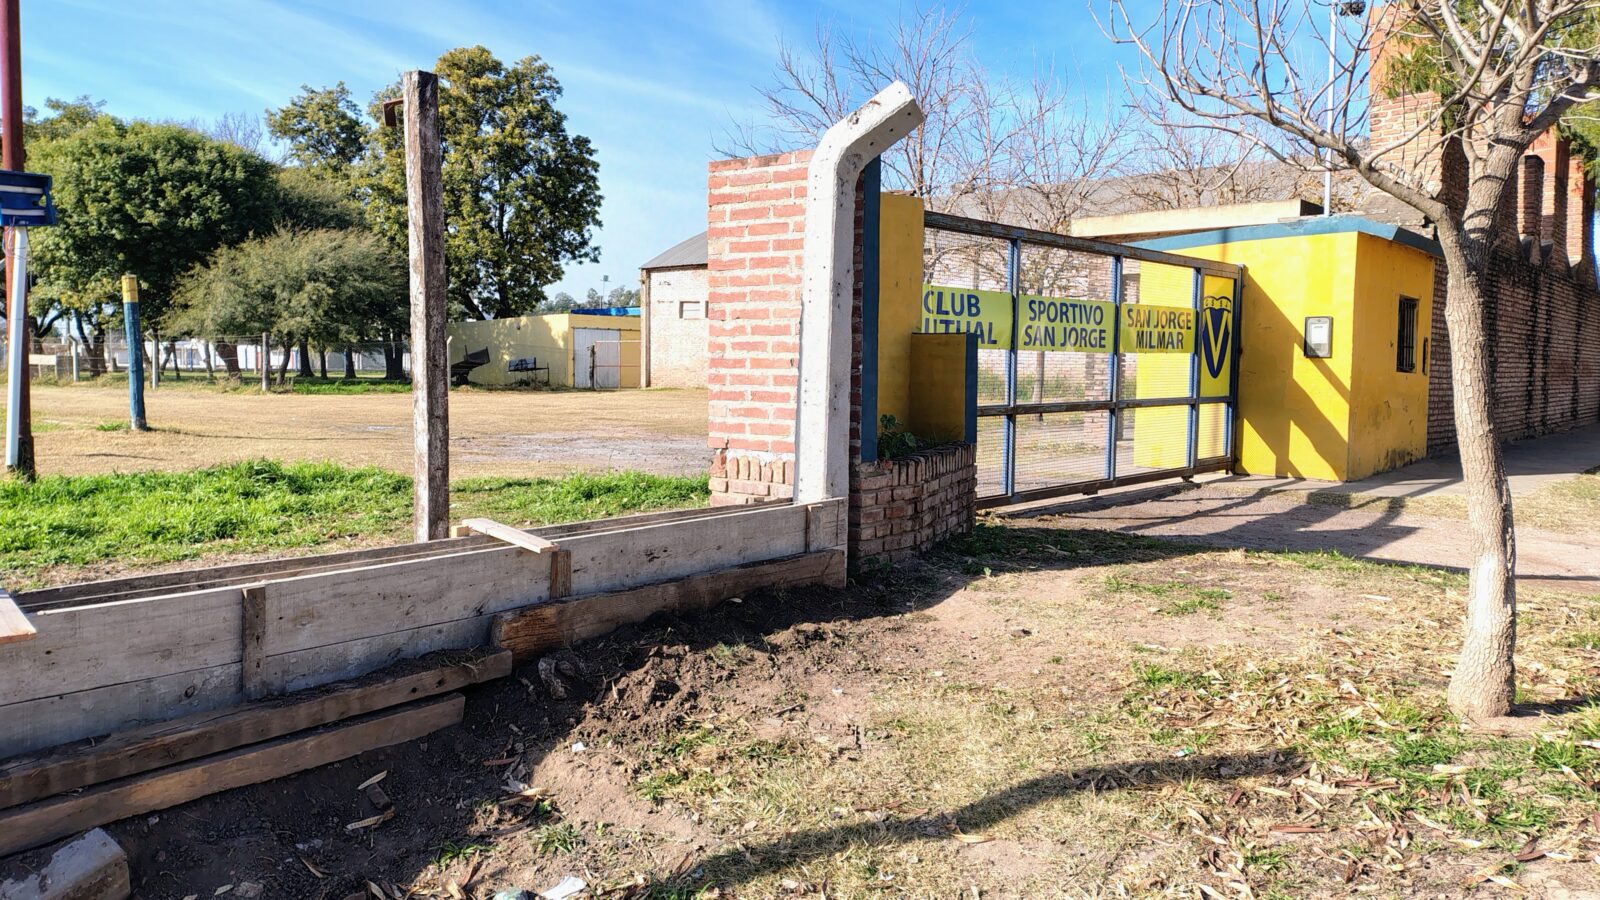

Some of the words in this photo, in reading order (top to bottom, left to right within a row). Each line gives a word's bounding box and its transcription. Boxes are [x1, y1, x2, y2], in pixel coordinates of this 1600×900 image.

[923, 290, 981, 317] CLUB
[1028, 300, 1104, 326] SPORTIVO
[1127, 308, 1151, 328] SAN
[1153, 309, 1192, 330] JORGE
[1023, 325, 1056, 347] SAN
[1060, 326, 1107, 349] JORGE
[1135, 330, 1184, 350] MILMAR
